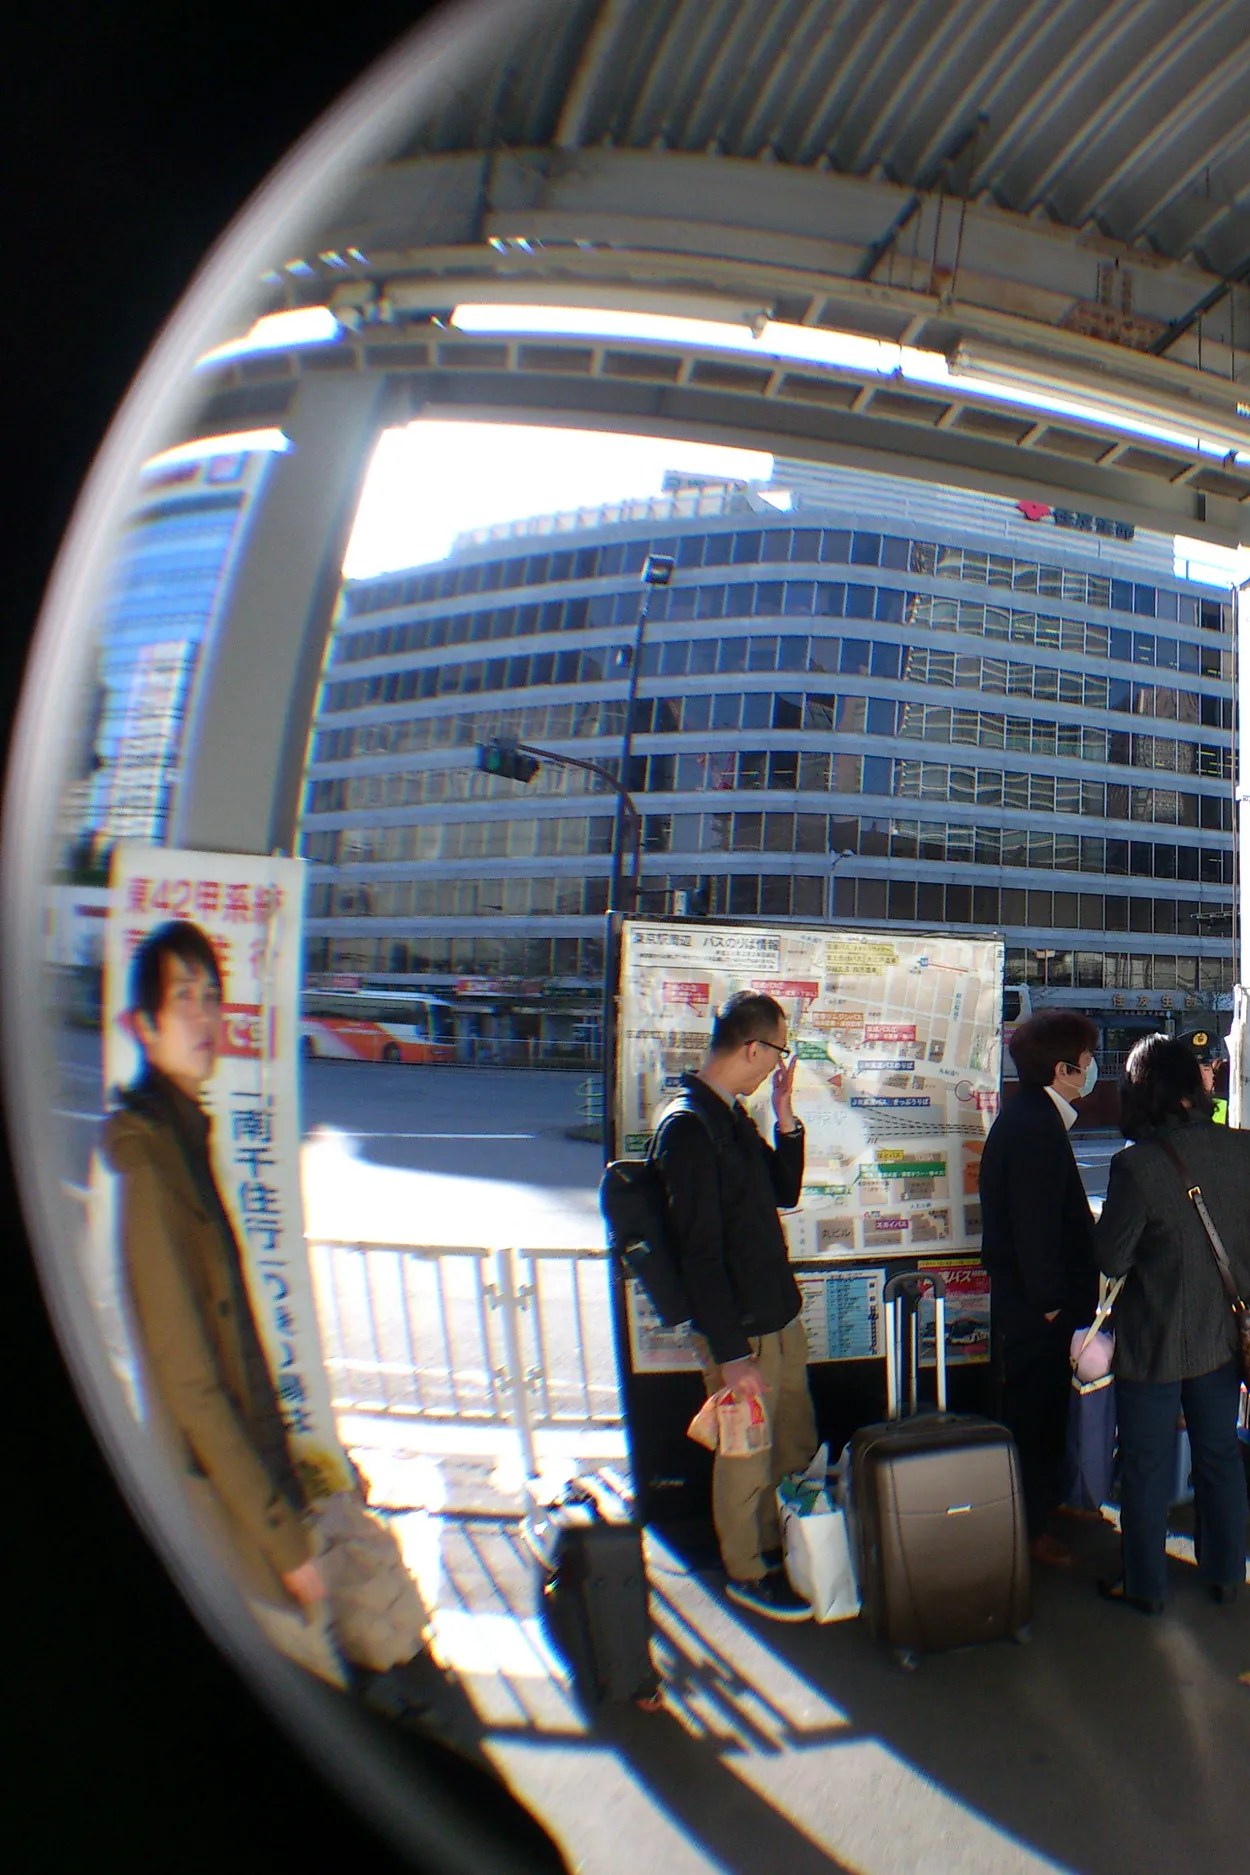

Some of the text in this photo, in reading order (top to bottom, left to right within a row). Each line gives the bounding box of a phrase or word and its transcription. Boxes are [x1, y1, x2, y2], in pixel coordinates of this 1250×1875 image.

[632, 932, 780, 950] 東京駅周辺 バスのりば情報
[893, 1097, 929, 1106] きっぷうりば
[876, 1151, 901, 1159] はとバス
[876, 1220, 908, 1229] スカイバス
